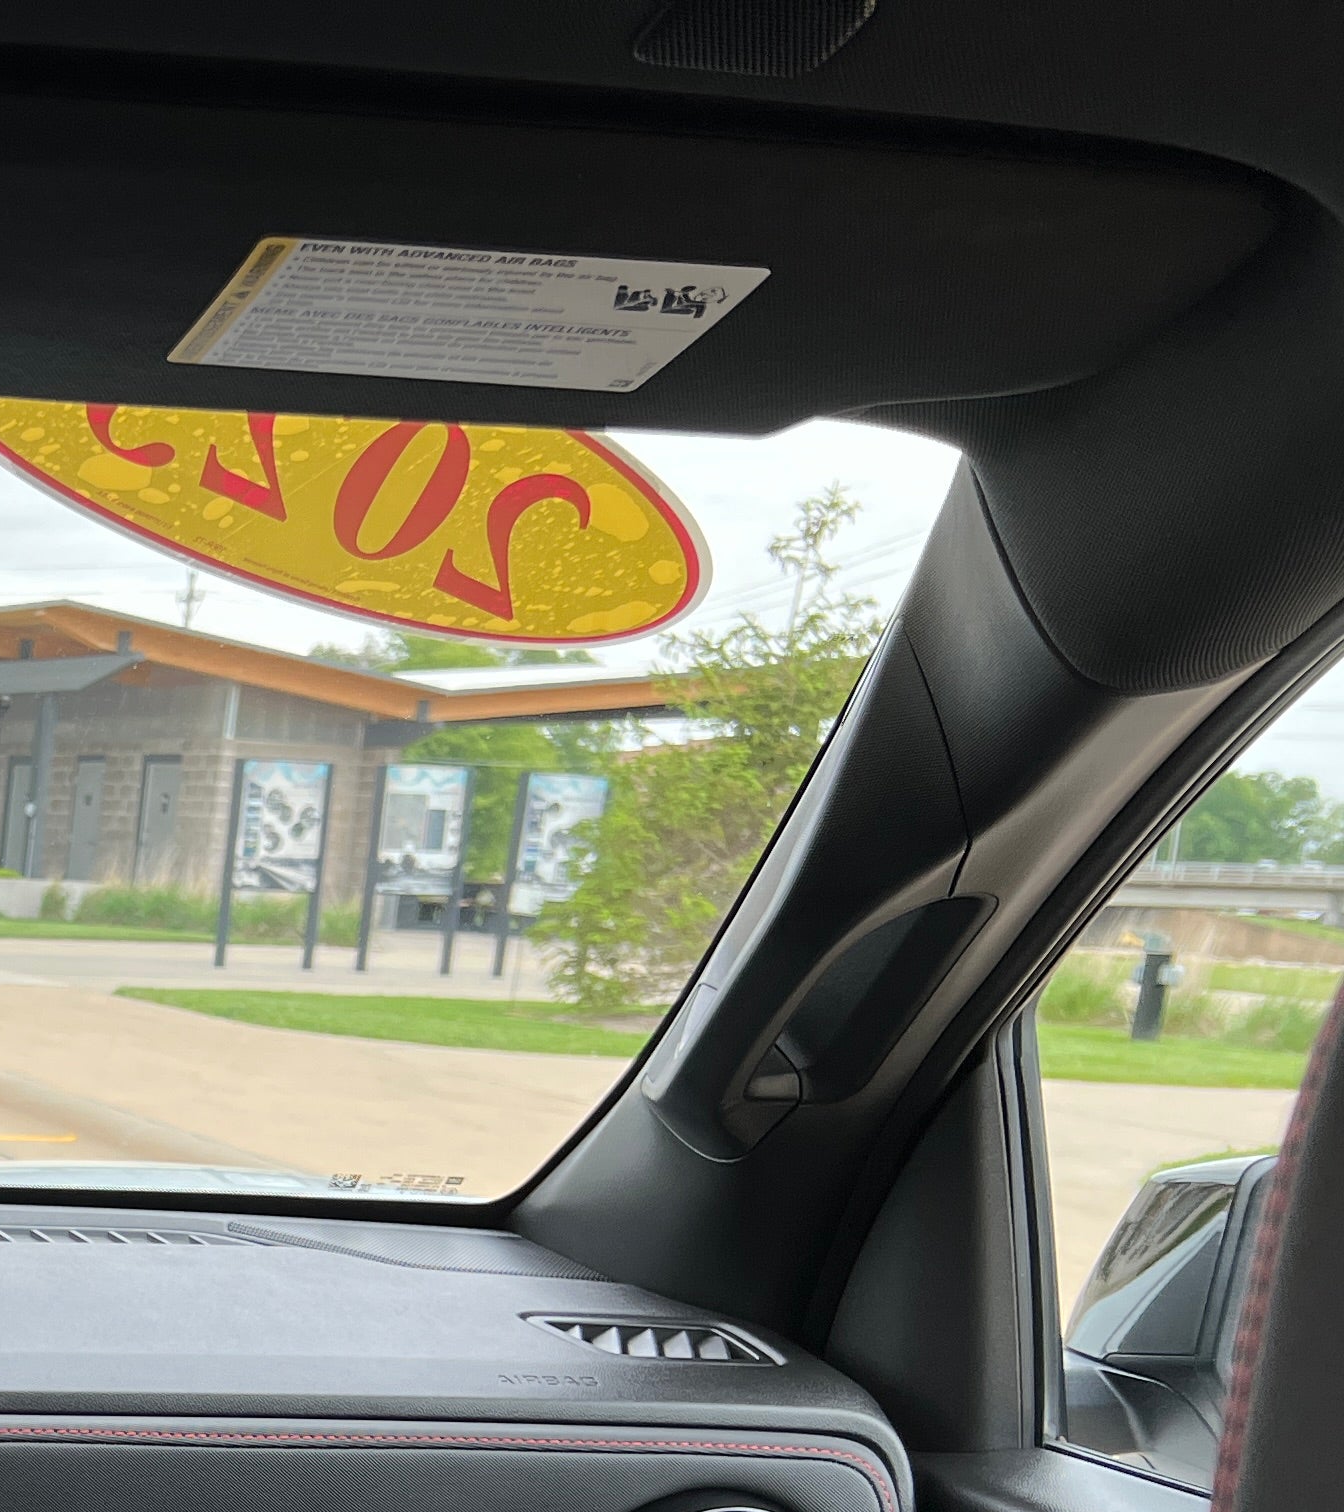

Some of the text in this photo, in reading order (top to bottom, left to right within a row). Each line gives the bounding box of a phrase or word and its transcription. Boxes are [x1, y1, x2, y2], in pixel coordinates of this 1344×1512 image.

[301, 243, 579, 269] EVEN WITH ADVANCED AIR BAGS
